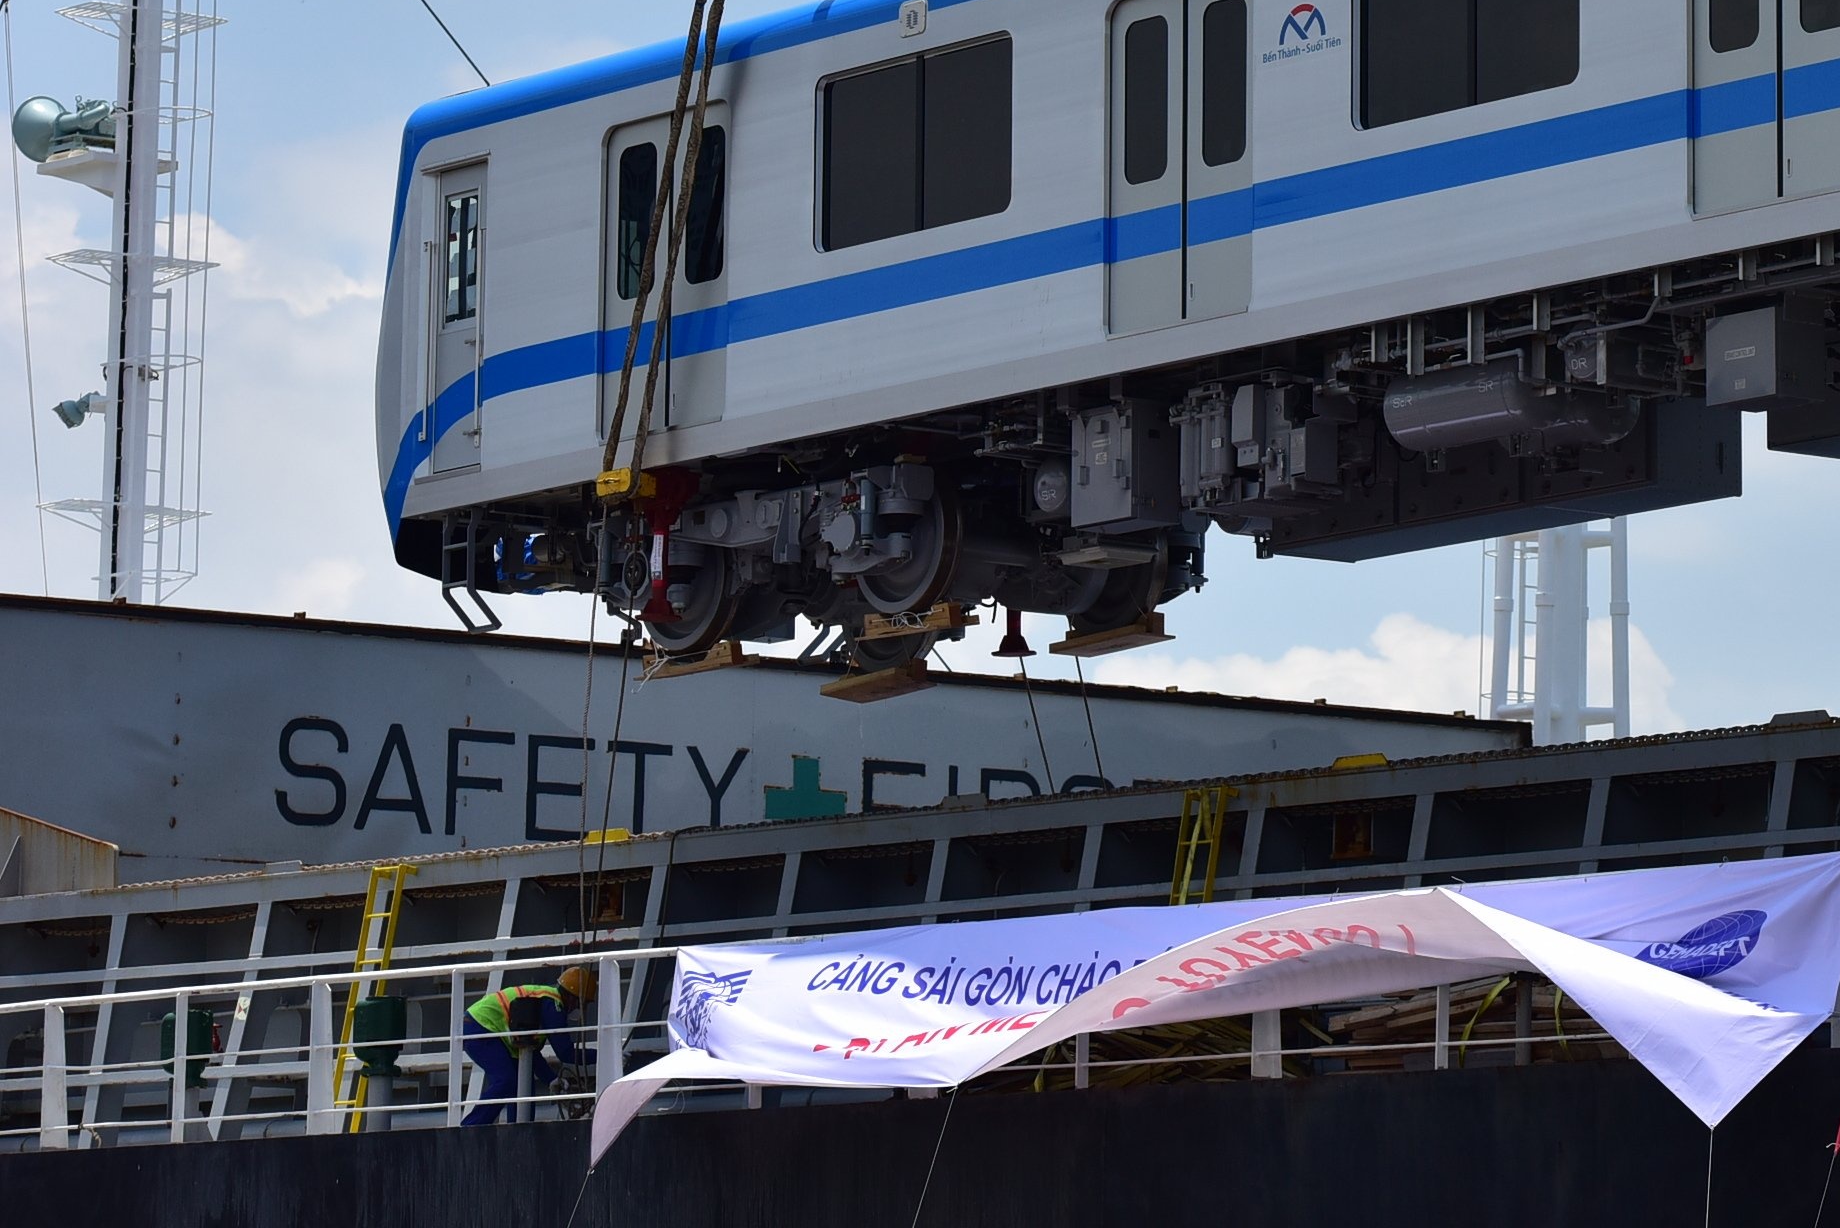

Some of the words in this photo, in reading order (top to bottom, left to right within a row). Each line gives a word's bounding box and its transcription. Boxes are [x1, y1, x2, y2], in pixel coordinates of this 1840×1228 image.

[1278, 45, 1301, 60] Thành
[1325, 36, 1342, 49] Tiên
[1571, 357, 1588, 370] DR
[1478, 380, 1493, 393] SR
[1041, 488, 1056, 501] SR
[274, 716, 751, 842] SAFETY
[806, 954, 905, 995] CẢNG
[901, 956, 966, 1005] SÀI
[964, 956, 1036, 1007] GÒN
